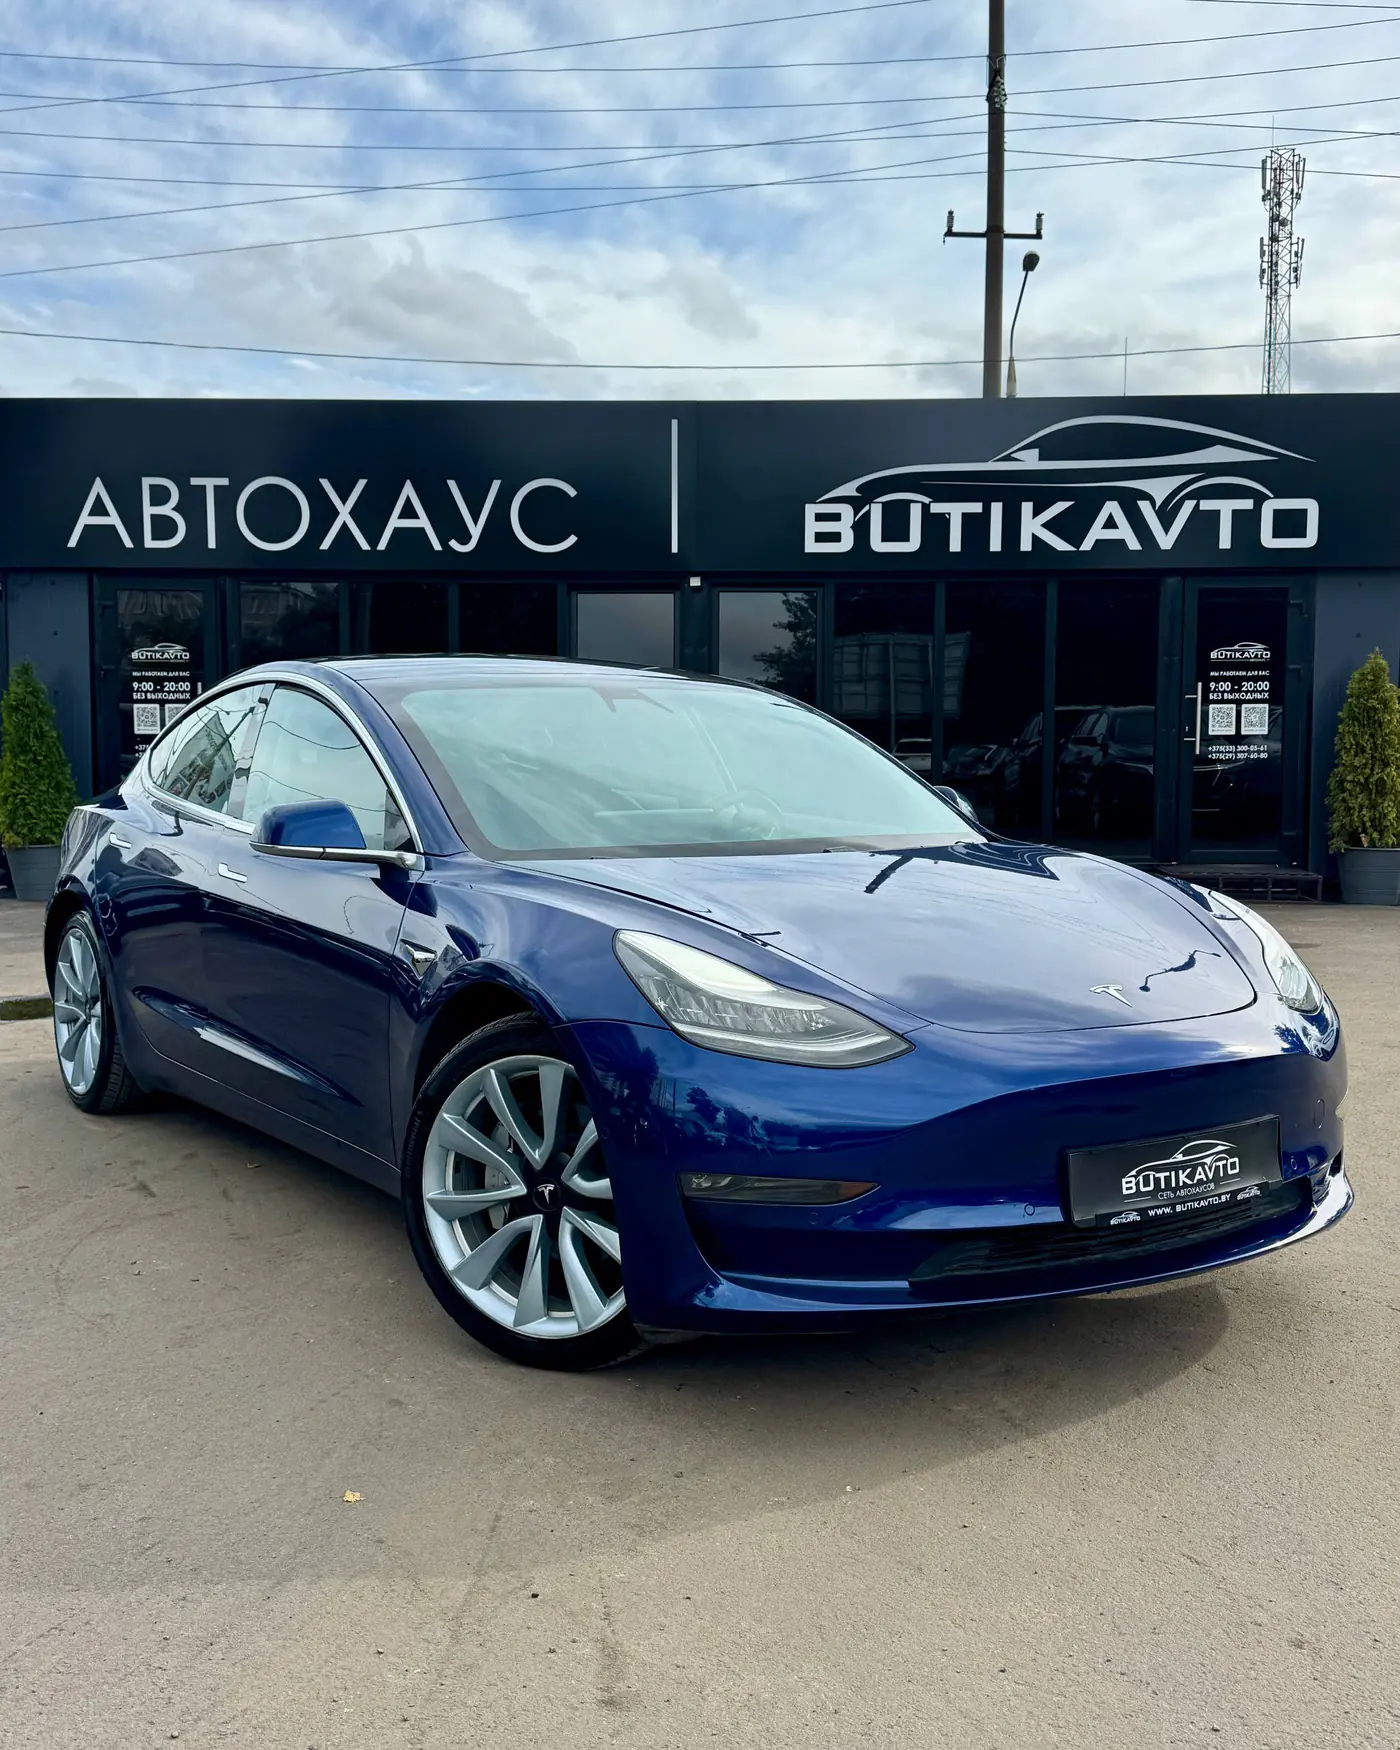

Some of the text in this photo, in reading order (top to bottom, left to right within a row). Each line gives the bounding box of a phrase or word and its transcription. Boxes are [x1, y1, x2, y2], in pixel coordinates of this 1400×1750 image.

[66, 475, 578, 554] АВТОХАУС
[804, 497, 1320, 554] BUTIKAVTO
[132, 682, 154, 691] 9:00
[163, 682, 191, 691] 20:00
[1209, 682, 1231, 691] 9:00
[1241, 682, 1270, 691] 20:00
[132, 692, 191, 700] БЕЗ ВЫХОДНЫХ
[1209, 692, 1269, 700] БЕЗ ВЫХОДНЫХ
[1208, 752, 1236, 760] +375(29)
[1122, 1158, 1240, 1194] BUTIKAVTO
[1157, 1182, 1216, 1200] СЕТЬ АВТОХАУСОВ
[1147, 1193, 1231, 1217] WWW. BUTIKAVTO.BY
